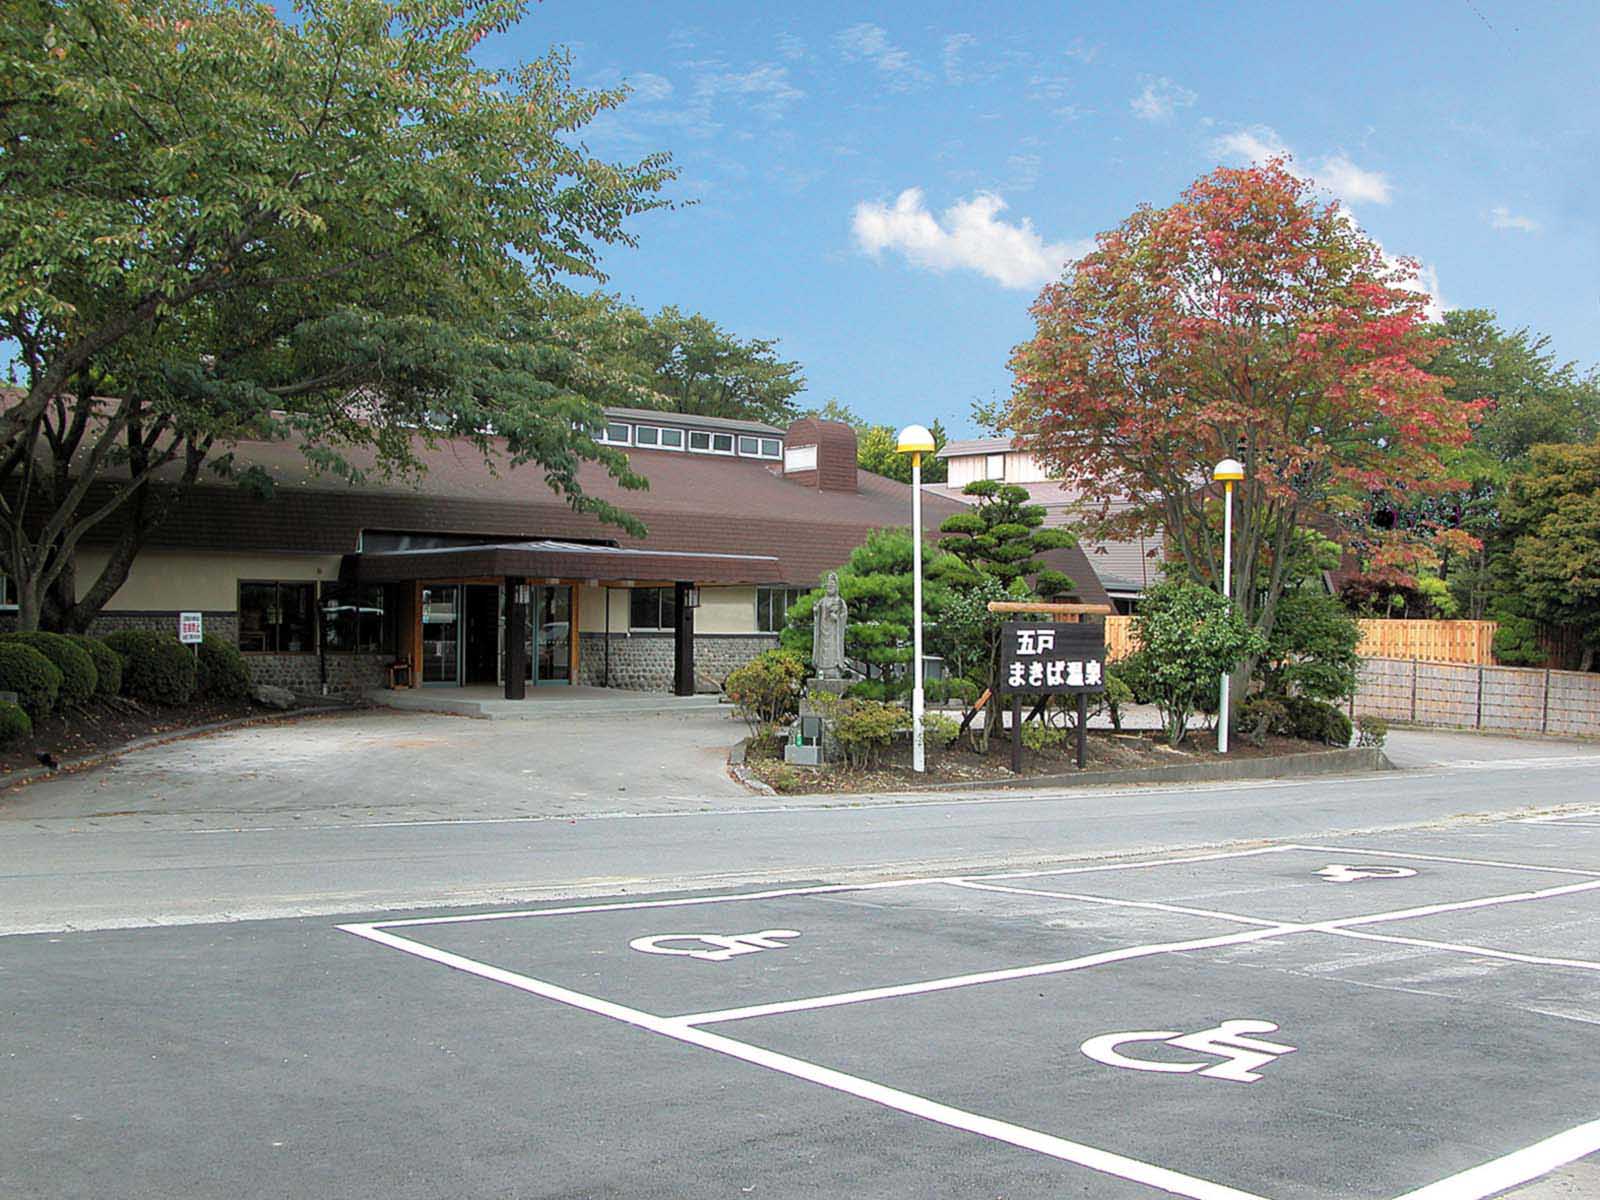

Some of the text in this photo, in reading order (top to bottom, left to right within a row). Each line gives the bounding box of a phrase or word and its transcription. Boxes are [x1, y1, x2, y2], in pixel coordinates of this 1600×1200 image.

[1016, 630, 1055, 654] 五戸
[1008, 660, 1102, 686] まきば温泉
